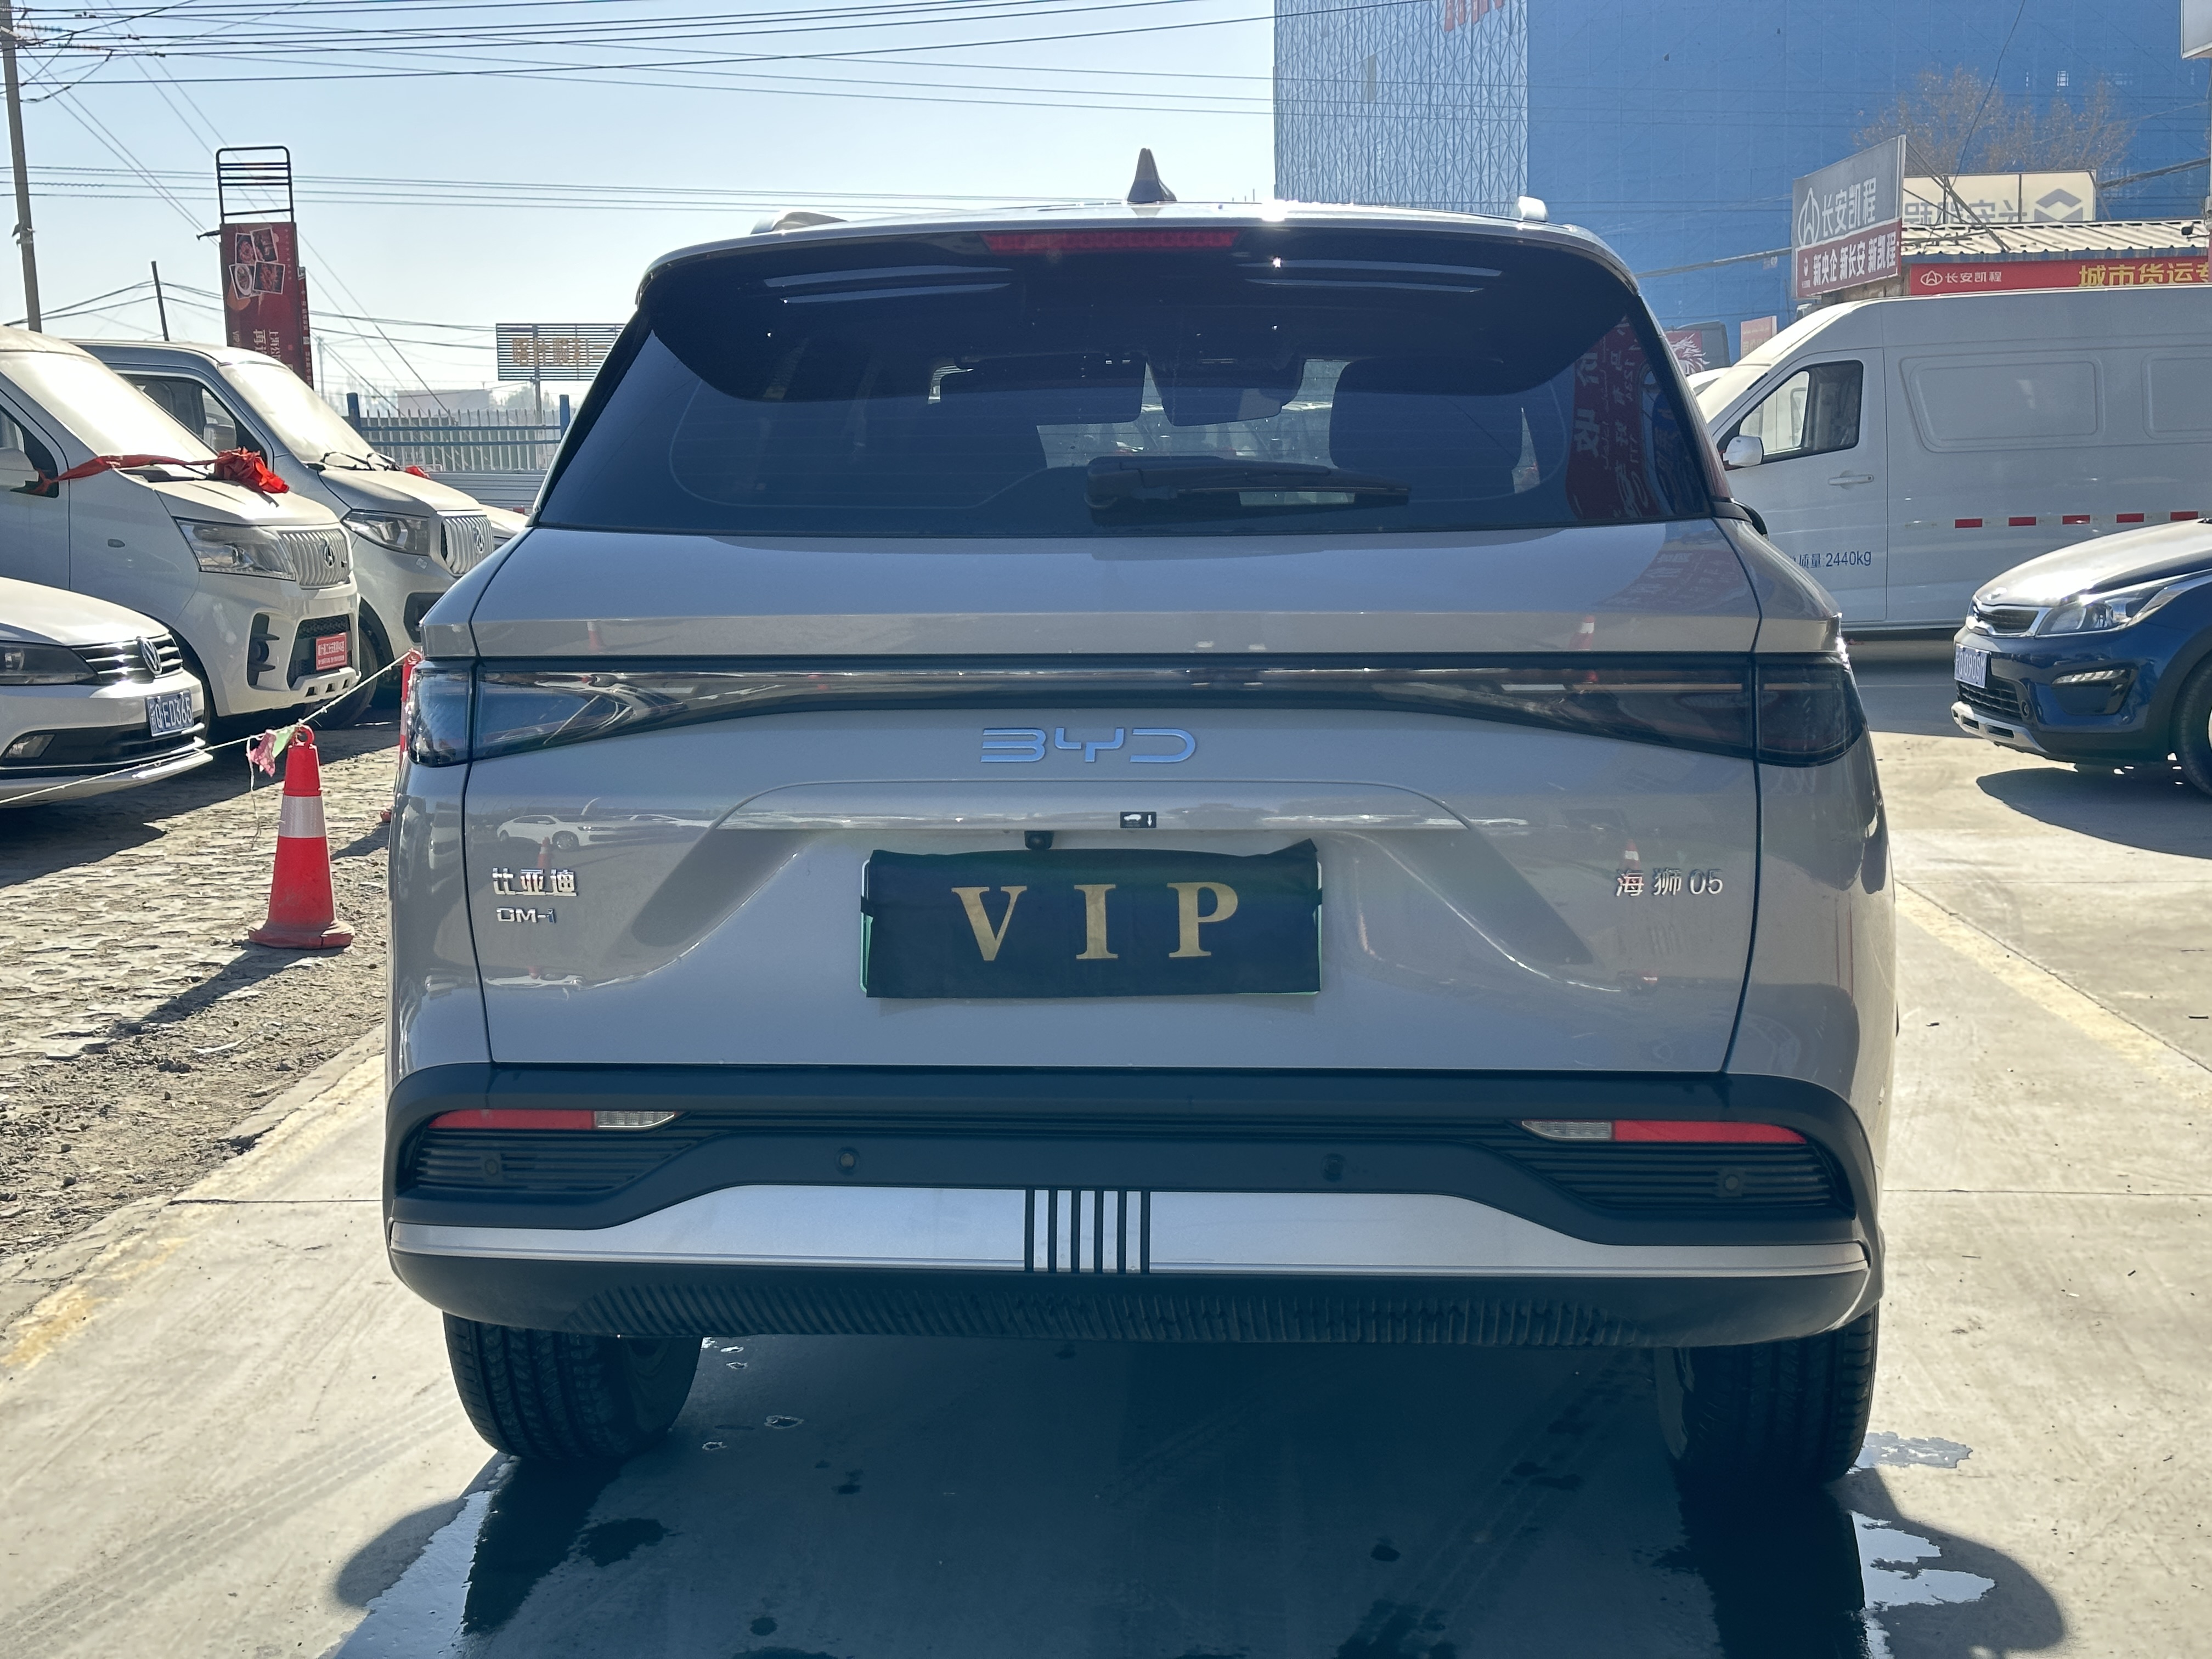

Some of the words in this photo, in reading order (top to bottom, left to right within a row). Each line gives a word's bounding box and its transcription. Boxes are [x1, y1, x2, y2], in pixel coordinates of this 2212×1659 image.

[1822, 177, 1876, 238] 长安凯程
[1813, 249, 1837, 286] 新央企
[1840, 240, 1865, 280] 新长安
[1868, 231, 1897, 273] 新凯程
[1945, 271, 2002, 283] 长安凯程
[1790, 550, 1871, 569] 质量:2440kg
[981, 727, 1197, 763] BYD
[492, 867, 577, 896] 比亚迪
[951, 881, 1239, 962] VIP
